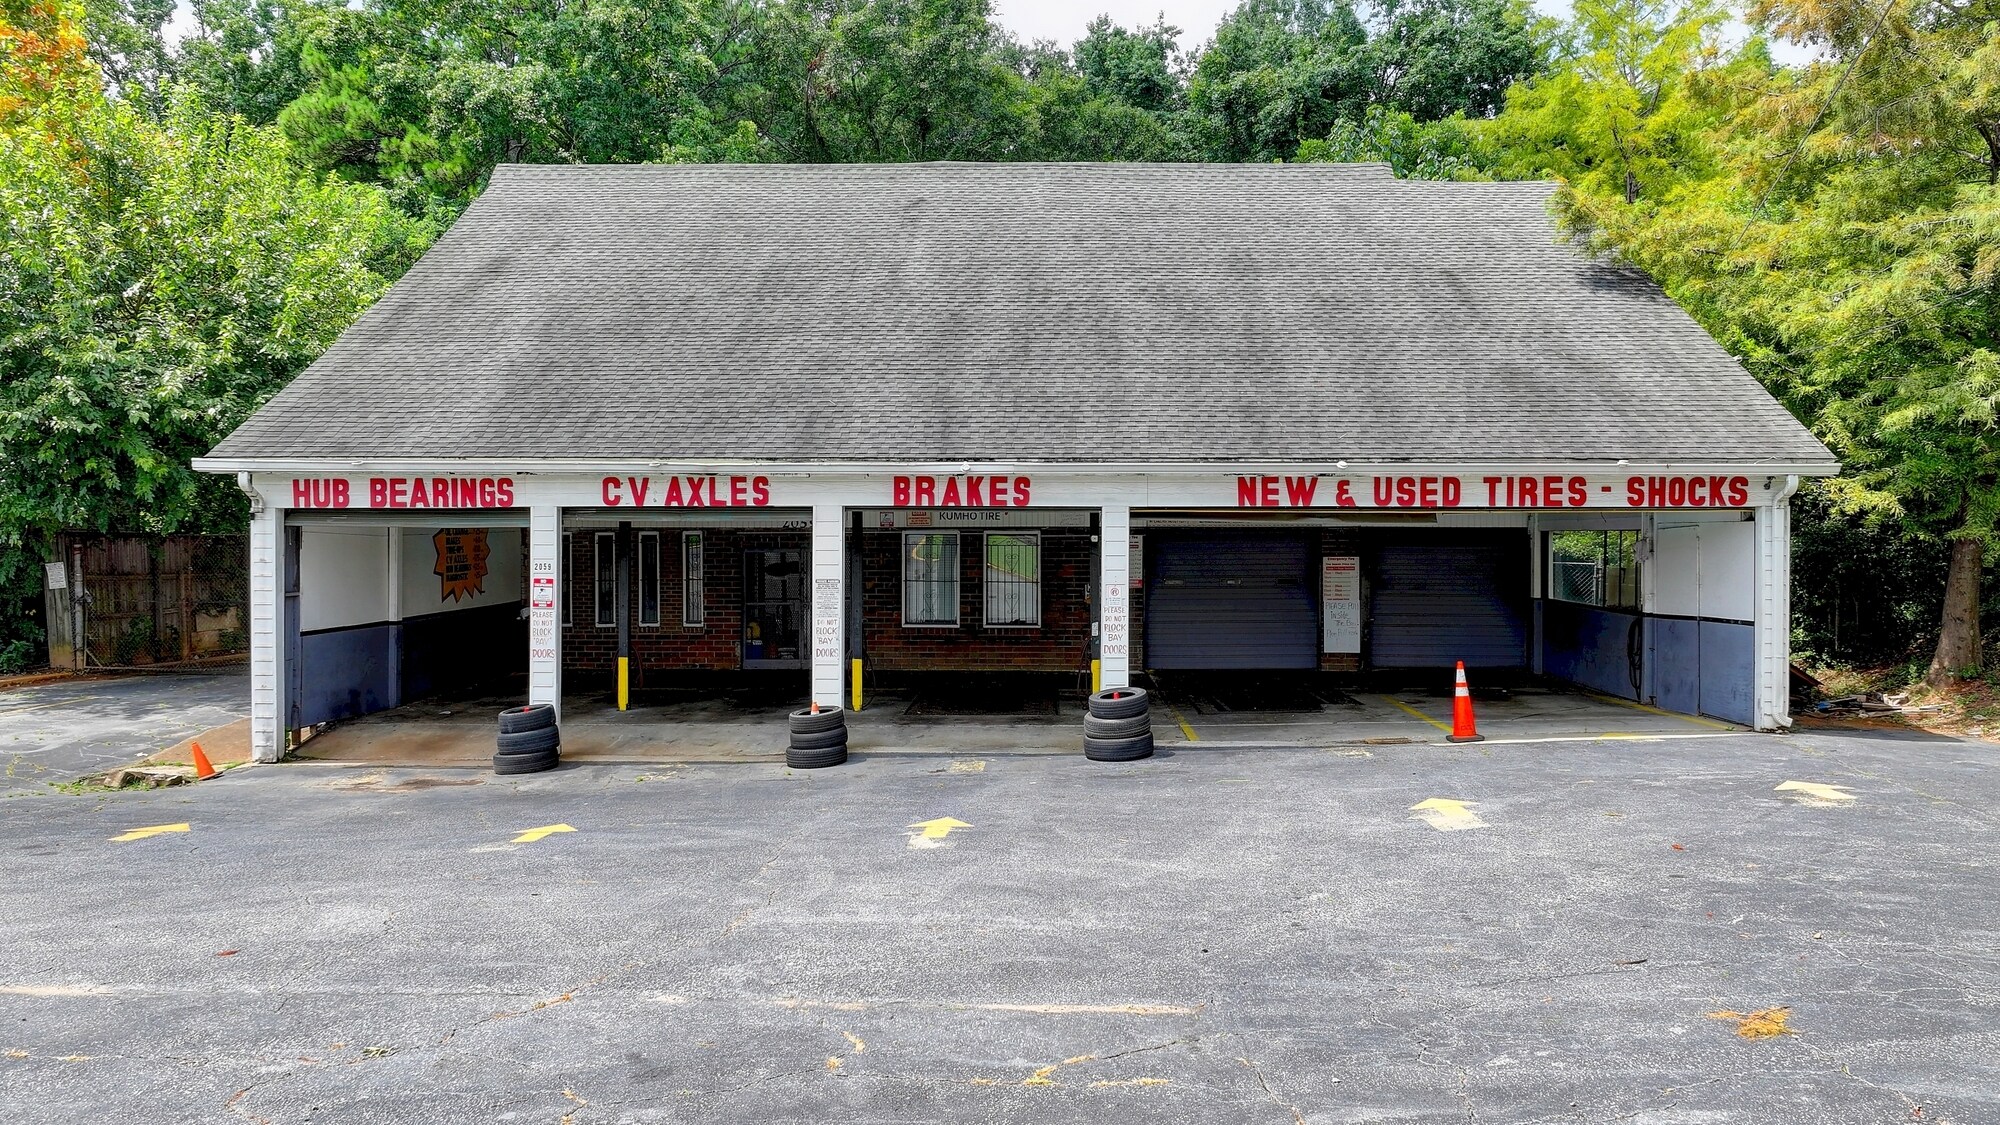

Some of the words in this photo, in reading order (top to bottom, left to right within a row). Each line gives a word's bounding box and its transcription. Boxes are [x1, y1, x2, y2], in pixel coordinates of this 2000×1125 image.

[292, 479, 349, 508] HUB
[369, 477, 515, 508] BEARINGS
[664, 476, 770, 507] AXLES
[893, 477, 1031, 507] BRAKES
[1237, 477, 1318, 508] NEW
[1335, 479, 1356, 508] &
[1373, 477, 1461, 508] USED
[1484, 476, 1587, 507] TIRES
[1627, 477, 1748, 508] SHOCKS
[939, 511, 978, 521] KUMHO
[980, 511, 1001, 521] TIRE
[534, 563, 552, 571] 2059
[532, 628, 553, 637] BLOCK
[816, 627, 838, 635] BLOCK
[1104, 623, 1127, 632] BLOCK
[532, 649, 555, 659] DOORS
[816, 648, 839, 657] DOORS
[1103, 645, 1127, 655] DOORS
